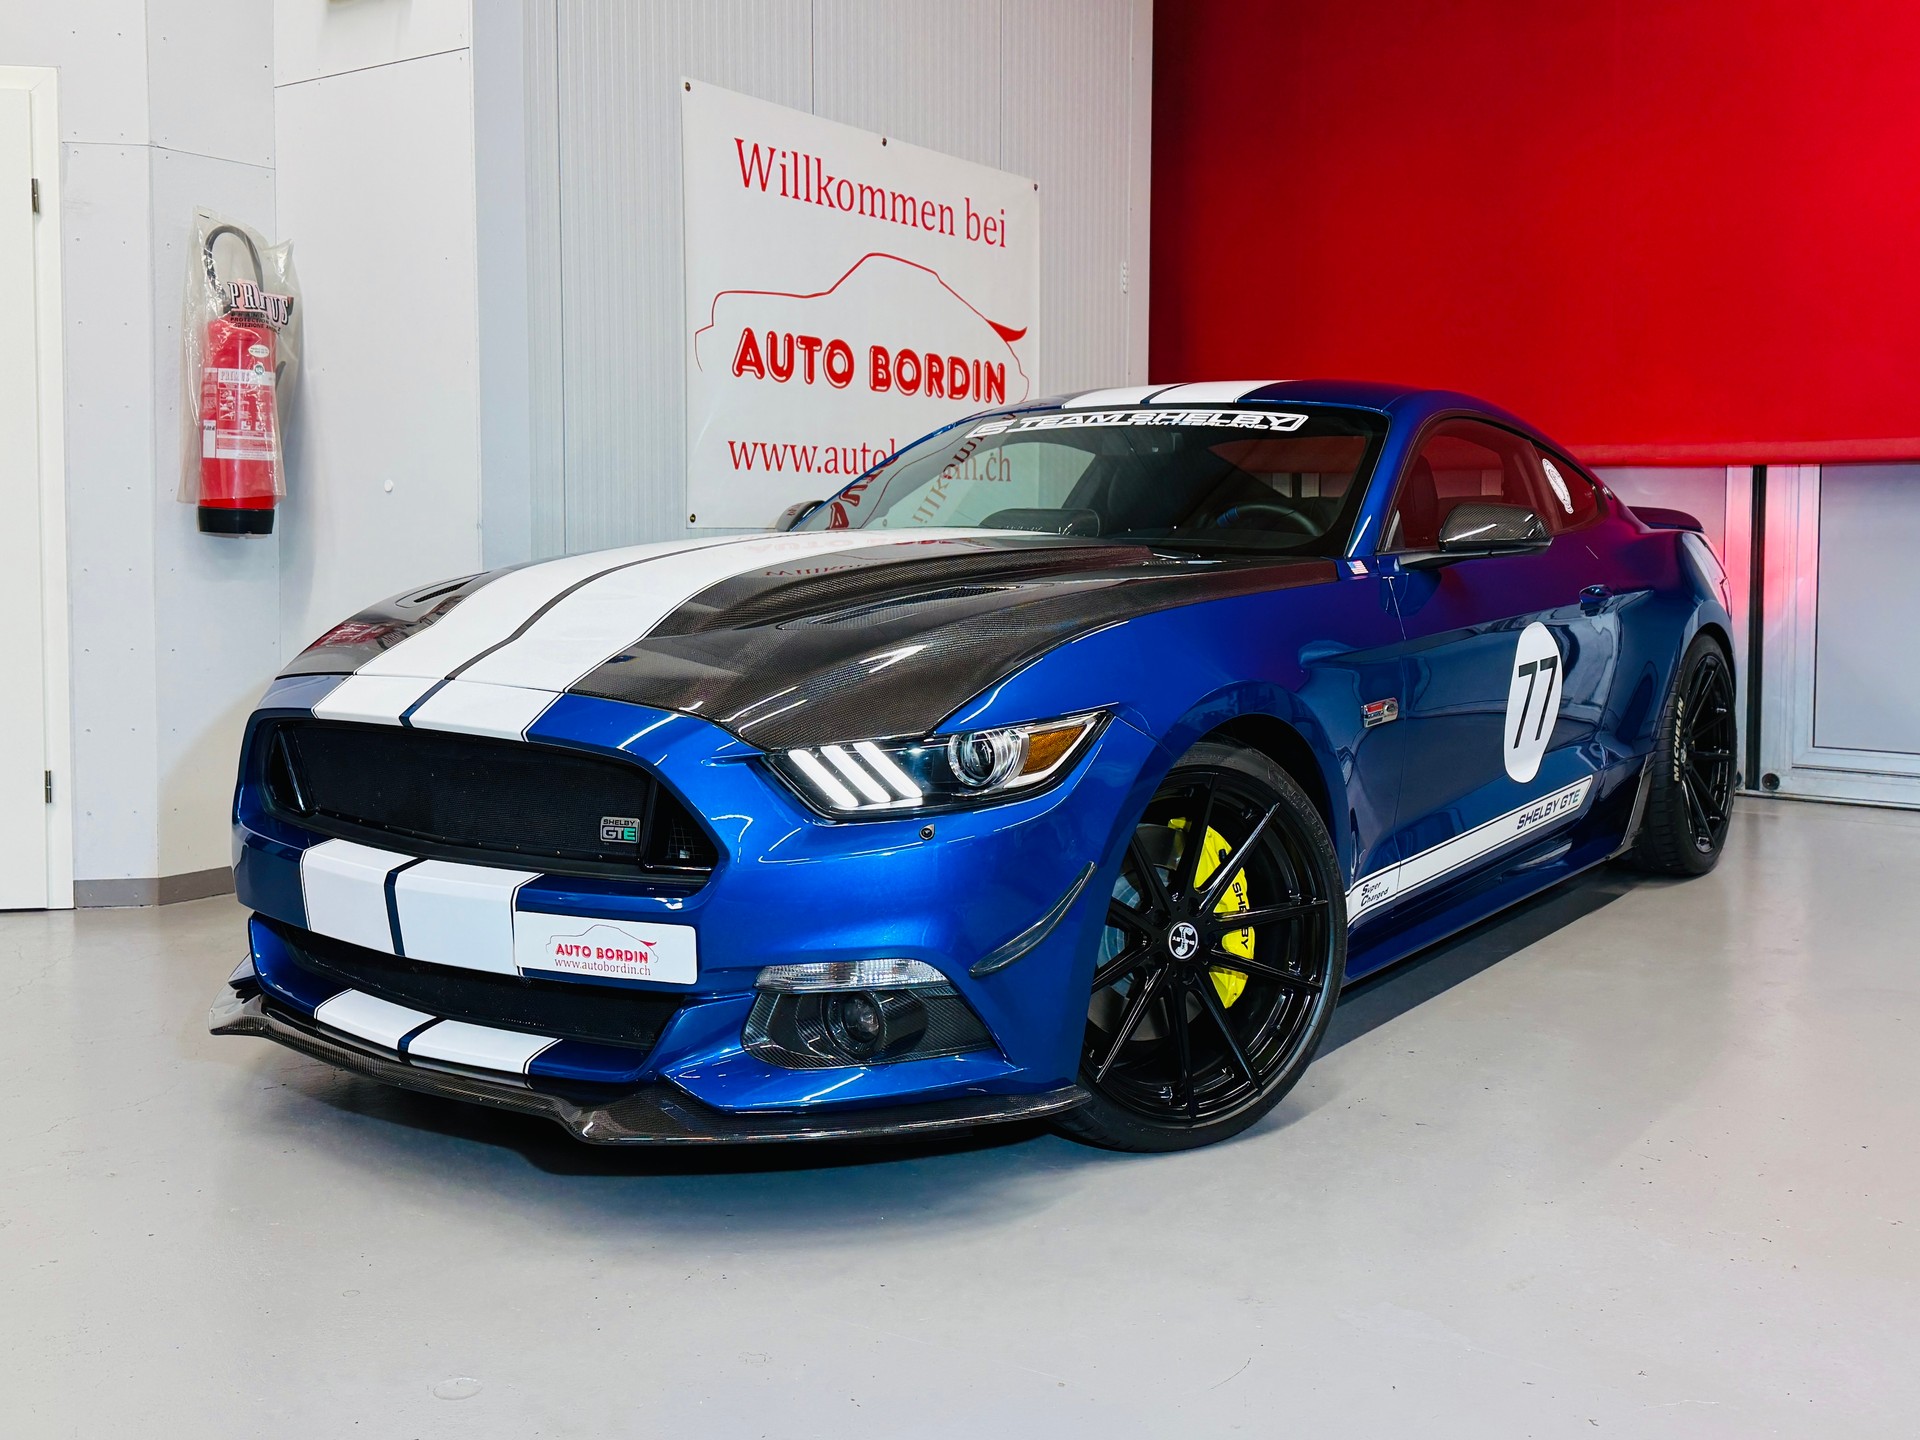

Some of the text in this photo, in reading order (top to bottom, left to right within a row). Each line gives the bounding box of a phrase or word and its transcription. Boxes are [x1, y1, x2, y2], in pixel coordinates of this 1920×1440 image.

[734, 137, 1006, 248] Willkommen bei
[227, 282, 288, 325] PRUS
[732, 327, 1006, 405] AUTO BORDIN
[1017, 411, 1128, 428] TEAM
[1128, 411, 1290, 427] SHELBY
[1513, 655, 1558, 750] 77
[1674, 696, 1685, 783] MICHELIN
[1517, 788, 1580, 830] SHELBY GTE
[602, 826, 636, 841] GTE
[1232, 882, 1249, 950] SHEBY
[554, 958, 651, 976] www.autobordin.ch
[556, 943, 648, 964] AUTO BORDIN
